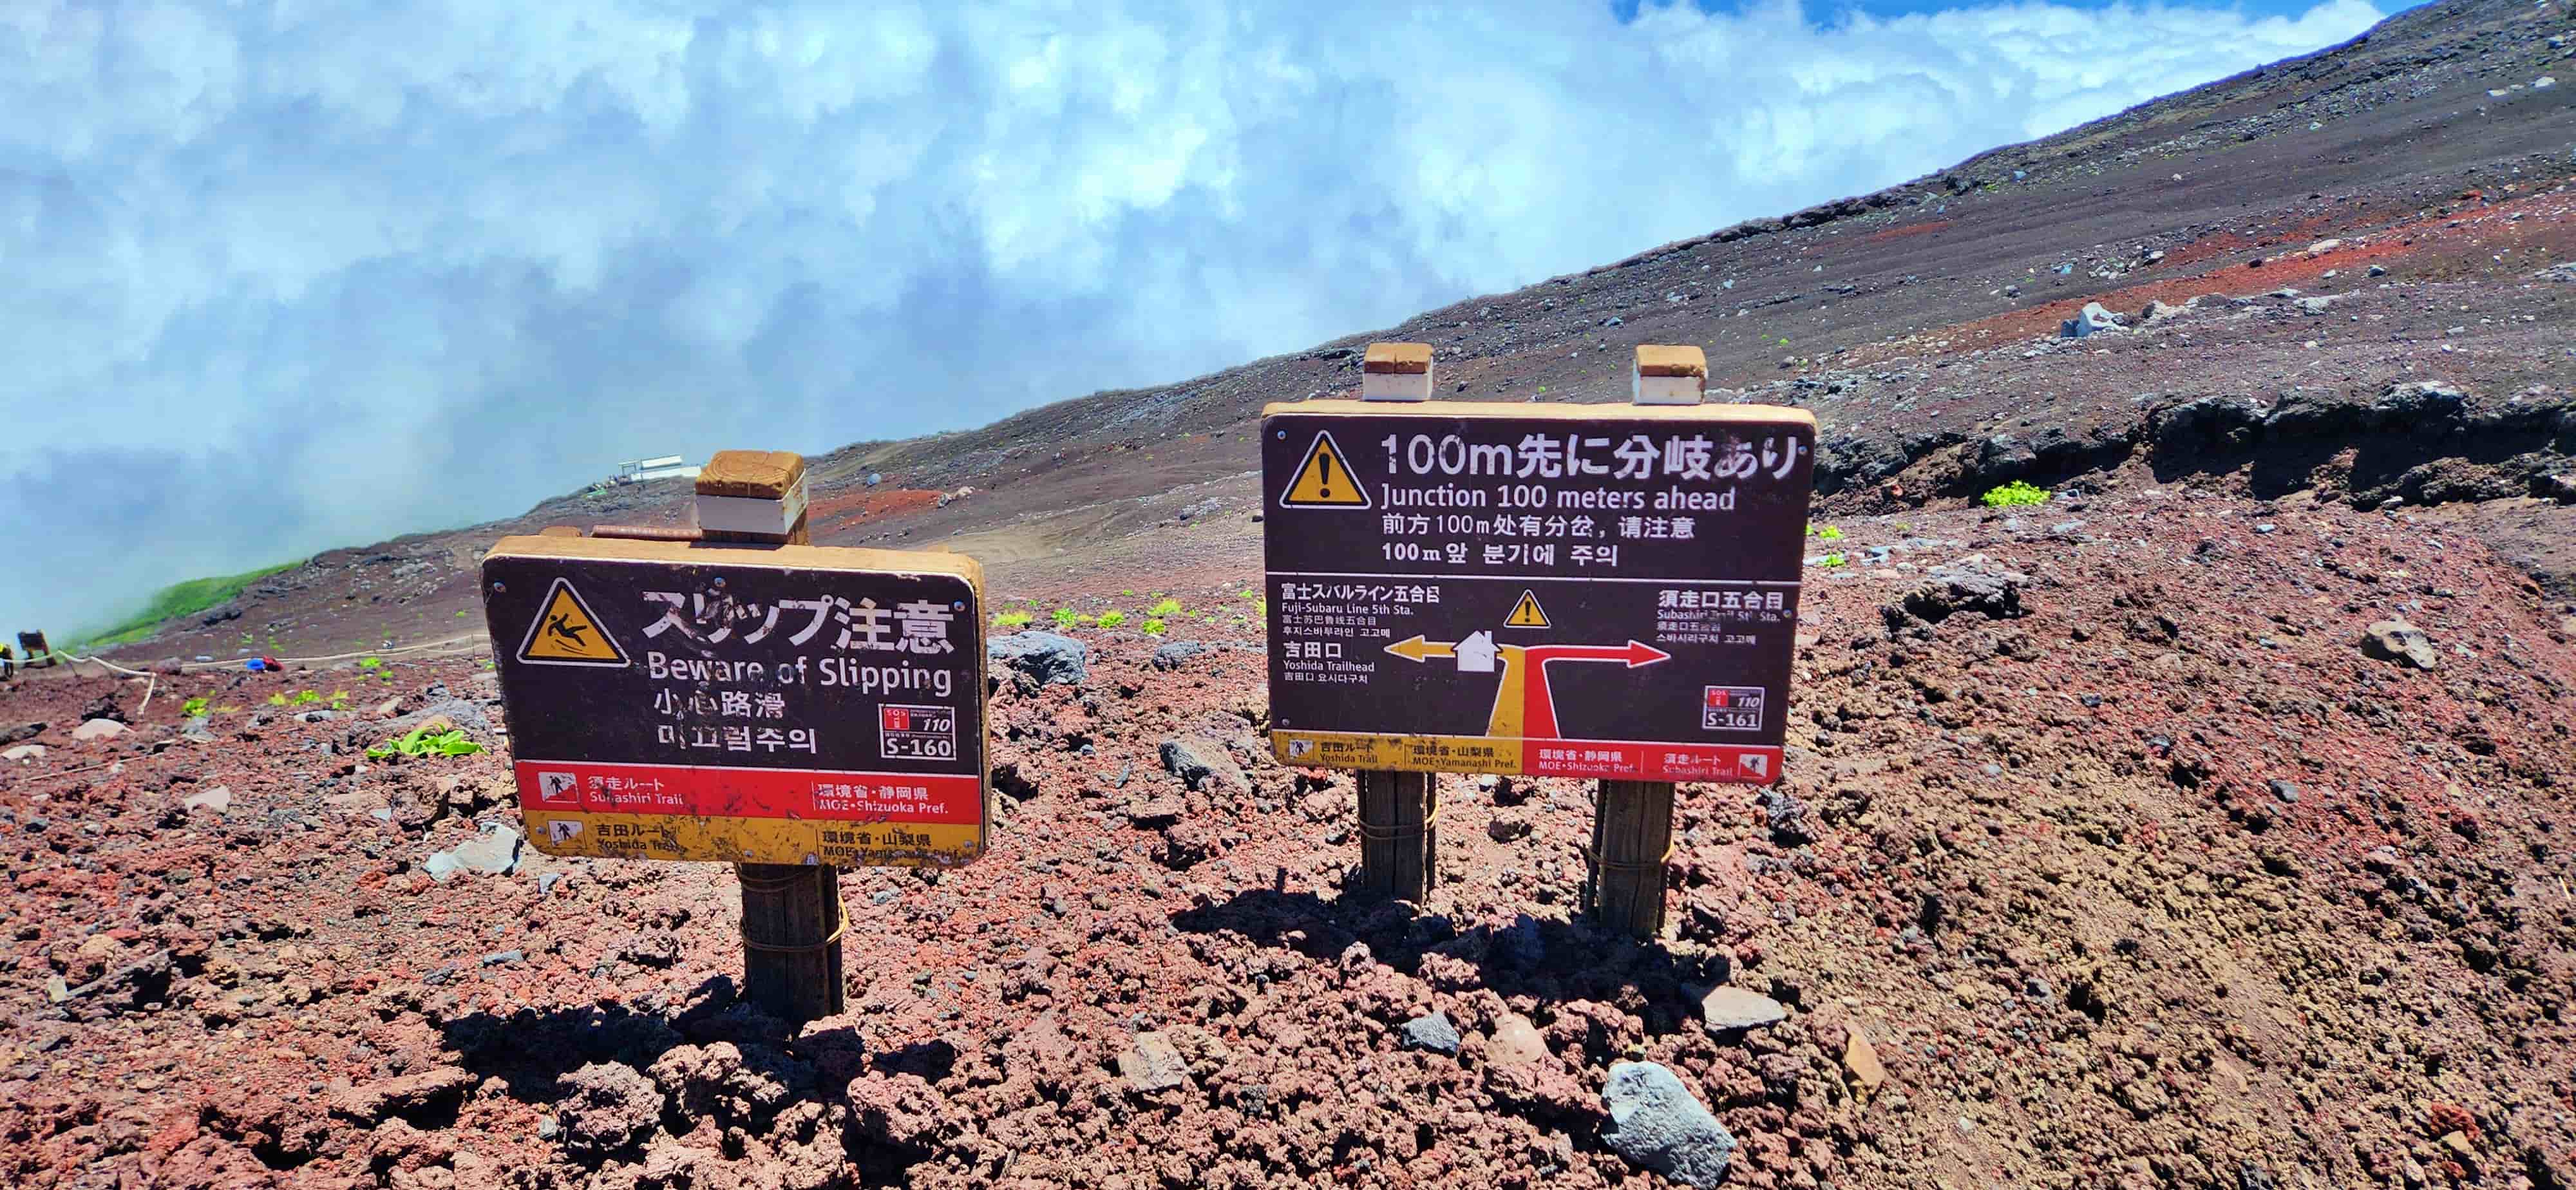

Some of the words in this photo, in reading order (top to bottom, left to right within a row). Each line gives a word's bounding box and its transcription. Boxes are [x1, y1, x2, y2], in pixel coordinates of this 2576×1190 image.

[1381, 433, 1797, 480] 100m先に分岐あり
[1381, 483, 1486, 509] Junction
[1497, 485, 1546, 508] 100
[1557, 487, 1645, 509] meters
[1654, 485, 1736, 510] ahead
[1482, 543, 1555, 565] 분기에
[1570, 545, 1618, 567] 주의
[1281, 583, 1440, 603] 富士スバルライン五合目
[1658, 590, 1783, 610] 須走口五合目
[1282, 603, 1343, 614] Fuji-Subaru
[1347, 604, 1369, 614] Line
[1372, 604, 1390, 615] 5th
[1393, 605, 1414, 616] Sta.
[642, 590, 954, 654] スリップ注意
[1283, 640, 1342, 658] 吉田口
[647, 651, 763, 682] Beware
[778, 656, 808, 685] of
[819, 657, 952, 697] Slipping
[1283, 660, 1324, 671] Yoshida
[1327, 661, 1376, 672] Trailhead
[1738, 697, 1760, 707] 110
[923, 718, 951, 732] 110
[1707, 712, 1757, 727] S-161
[887, 737, 951, 756] S-160
[1320, 753, 1356, 763] Yoshida
[919, 803, 949, 814] Pref.
